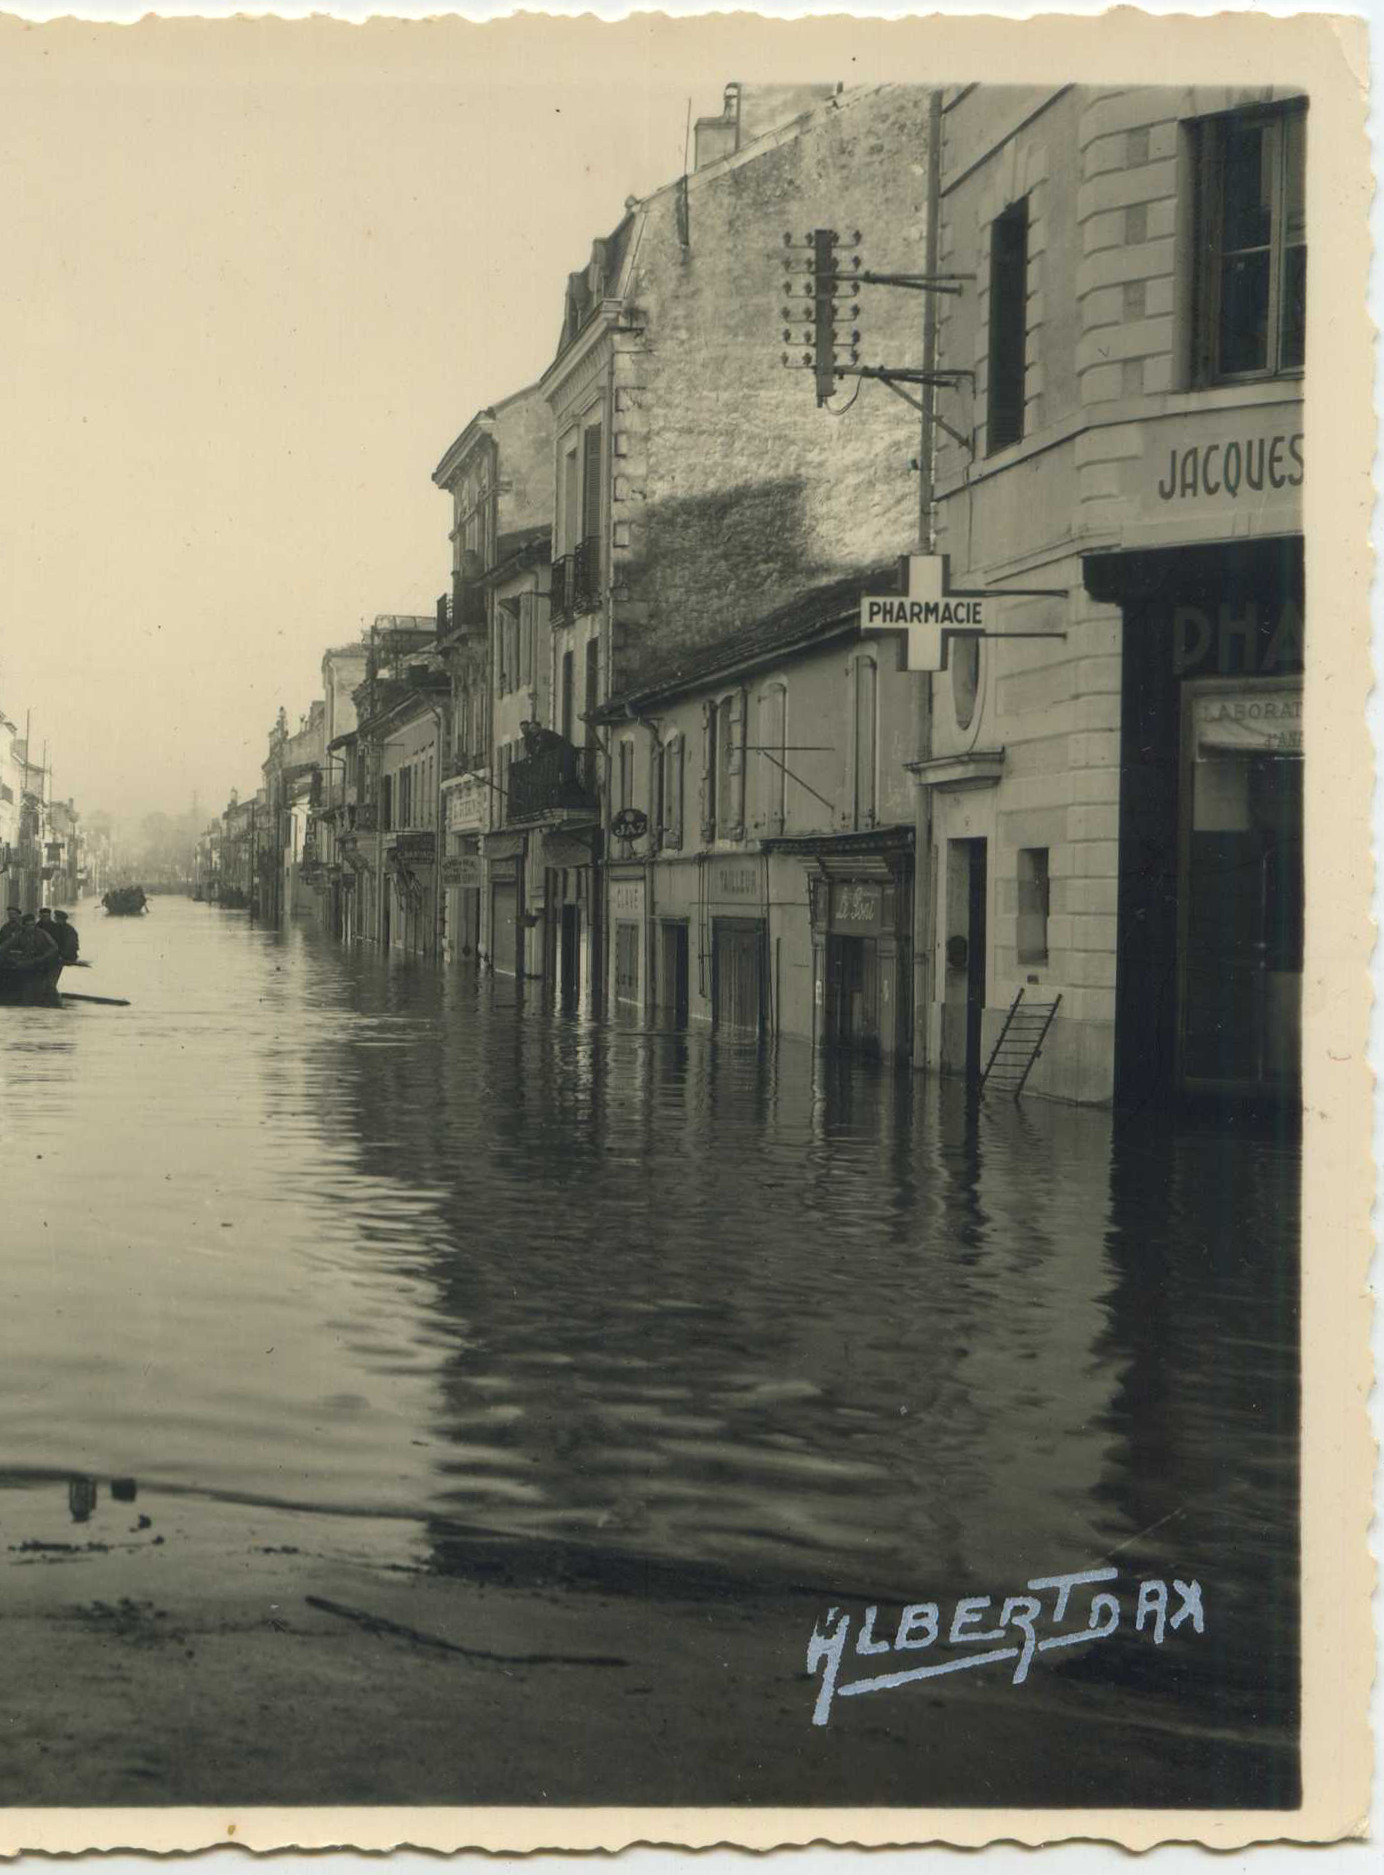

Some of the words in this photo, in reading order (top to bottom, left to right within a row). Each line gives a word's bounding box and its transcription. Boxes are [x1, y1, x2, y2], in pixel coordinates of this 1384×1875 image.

[1158, 435, 1303, 499] JACQUES
[868, 600, 983, 625] PHARMACIE
[616, 824, 646, 836] JAZ
